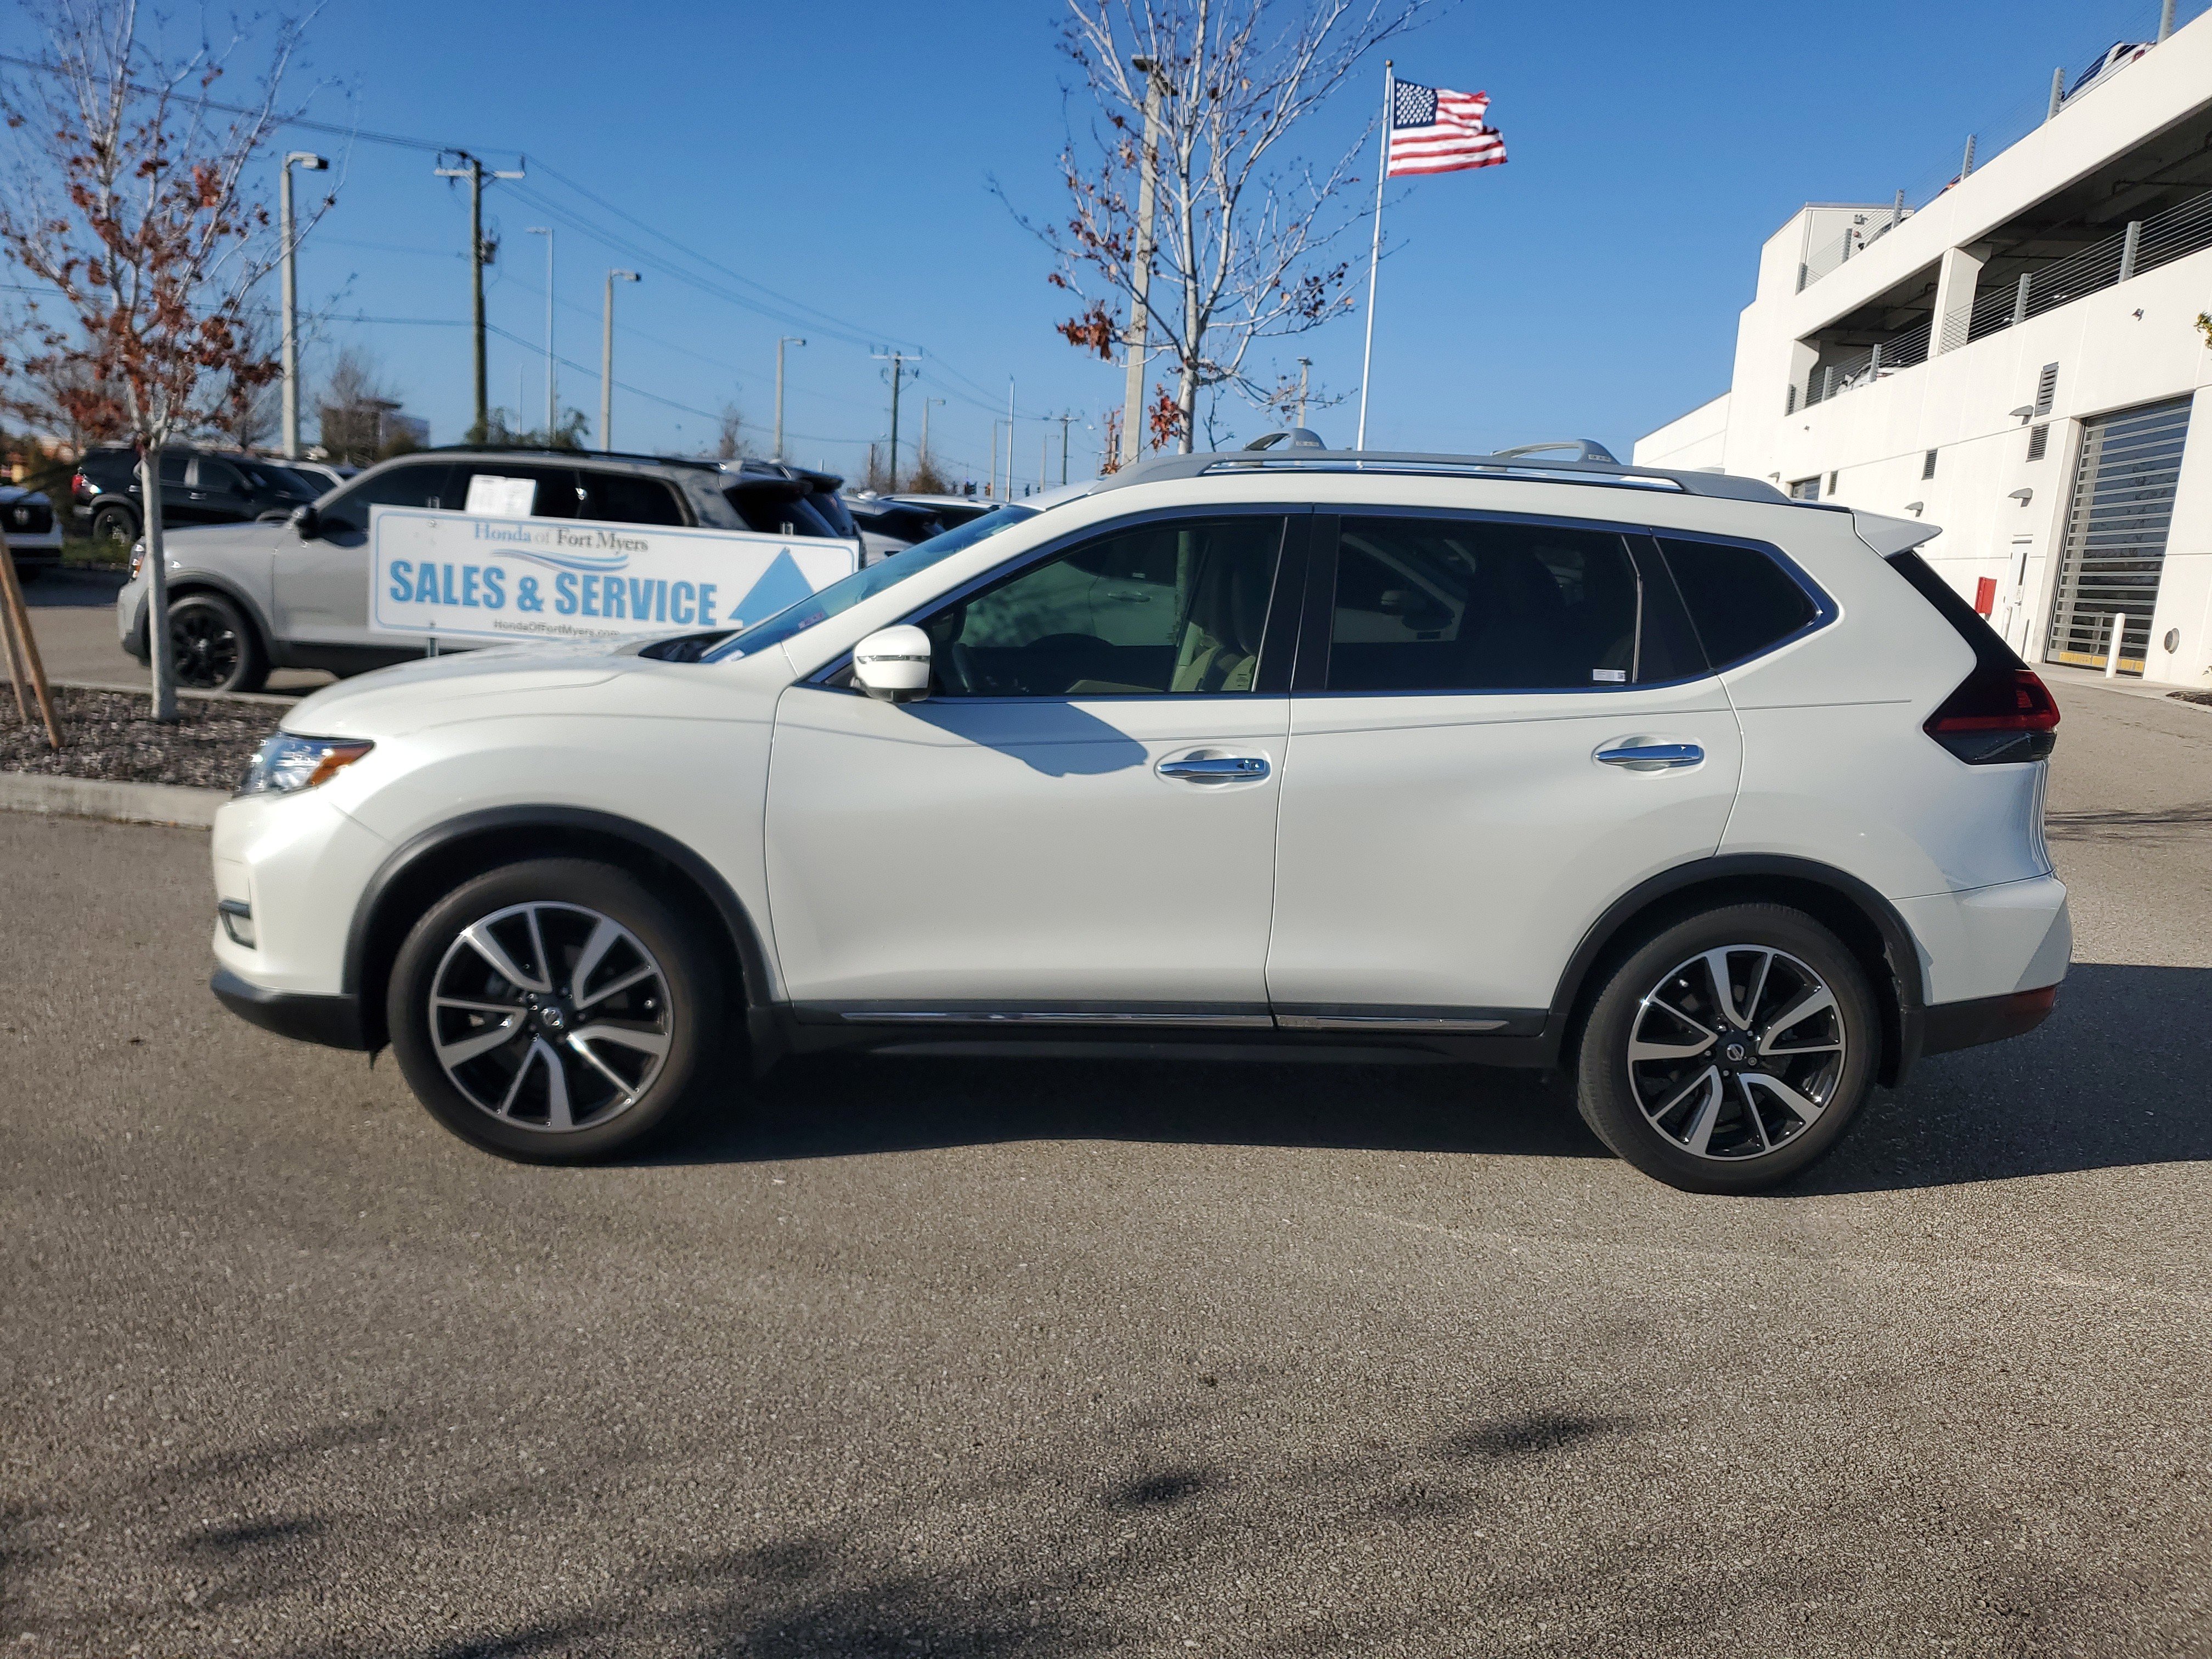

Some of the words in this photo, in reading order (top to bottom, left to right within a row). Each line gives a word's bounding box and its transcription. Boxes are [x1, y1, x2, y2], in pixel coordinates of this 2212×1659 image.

[475, 522, 532, 543] Honda
[534, 527, 551, 544] of
[556, 527, 592, 546] Fort
[596, 531, 650, 555] Myers
[390, 560, 506, 609] SALES
[517, 576, 544, 612] &
[554, 572, 718, 625] SERVICE
